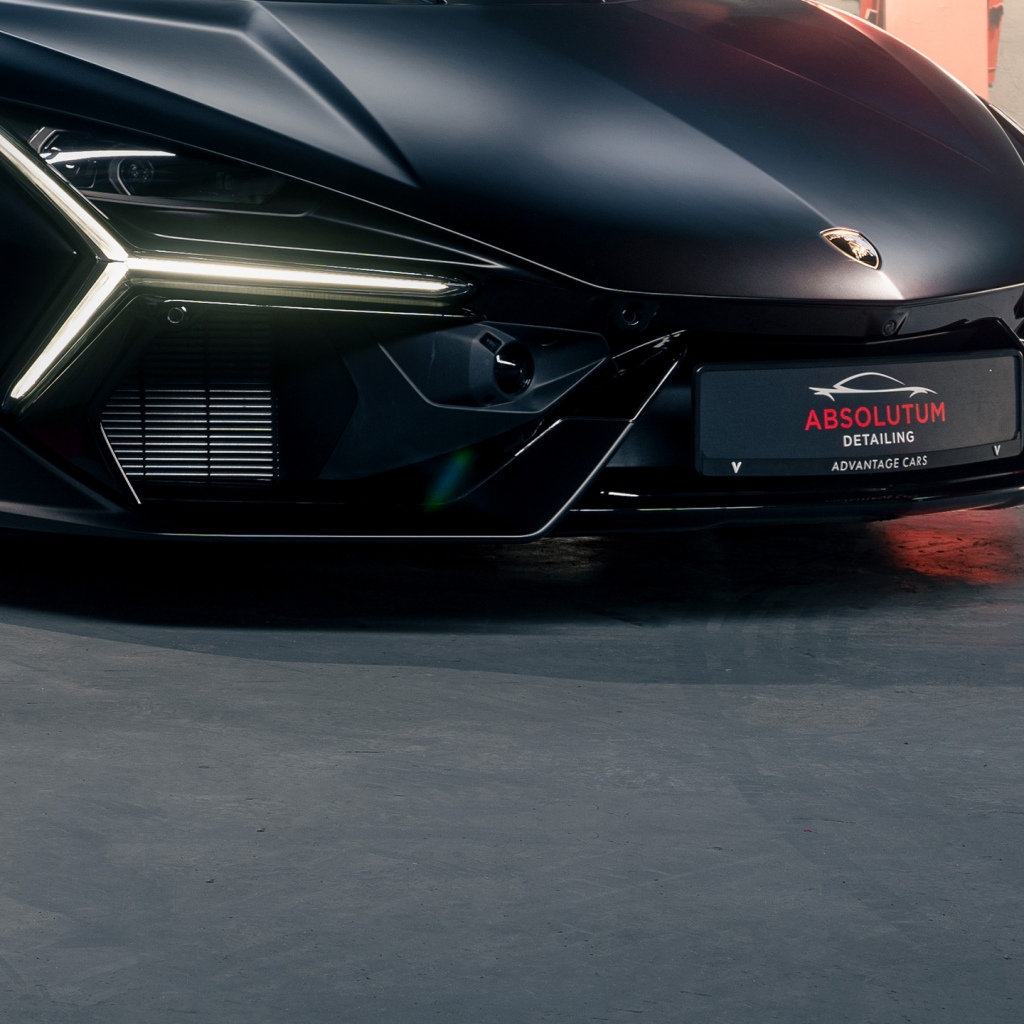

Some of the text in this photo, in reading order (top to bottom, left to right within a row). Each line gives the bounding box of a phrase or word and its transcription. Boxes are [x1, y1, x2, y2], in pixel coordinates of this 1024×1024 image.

[804, 401, 946, 431] ABSOLUTUM
[842, 430, 915, 448] DETAILING
[831, 455, 929, 472] ADVANTAGE CARS
